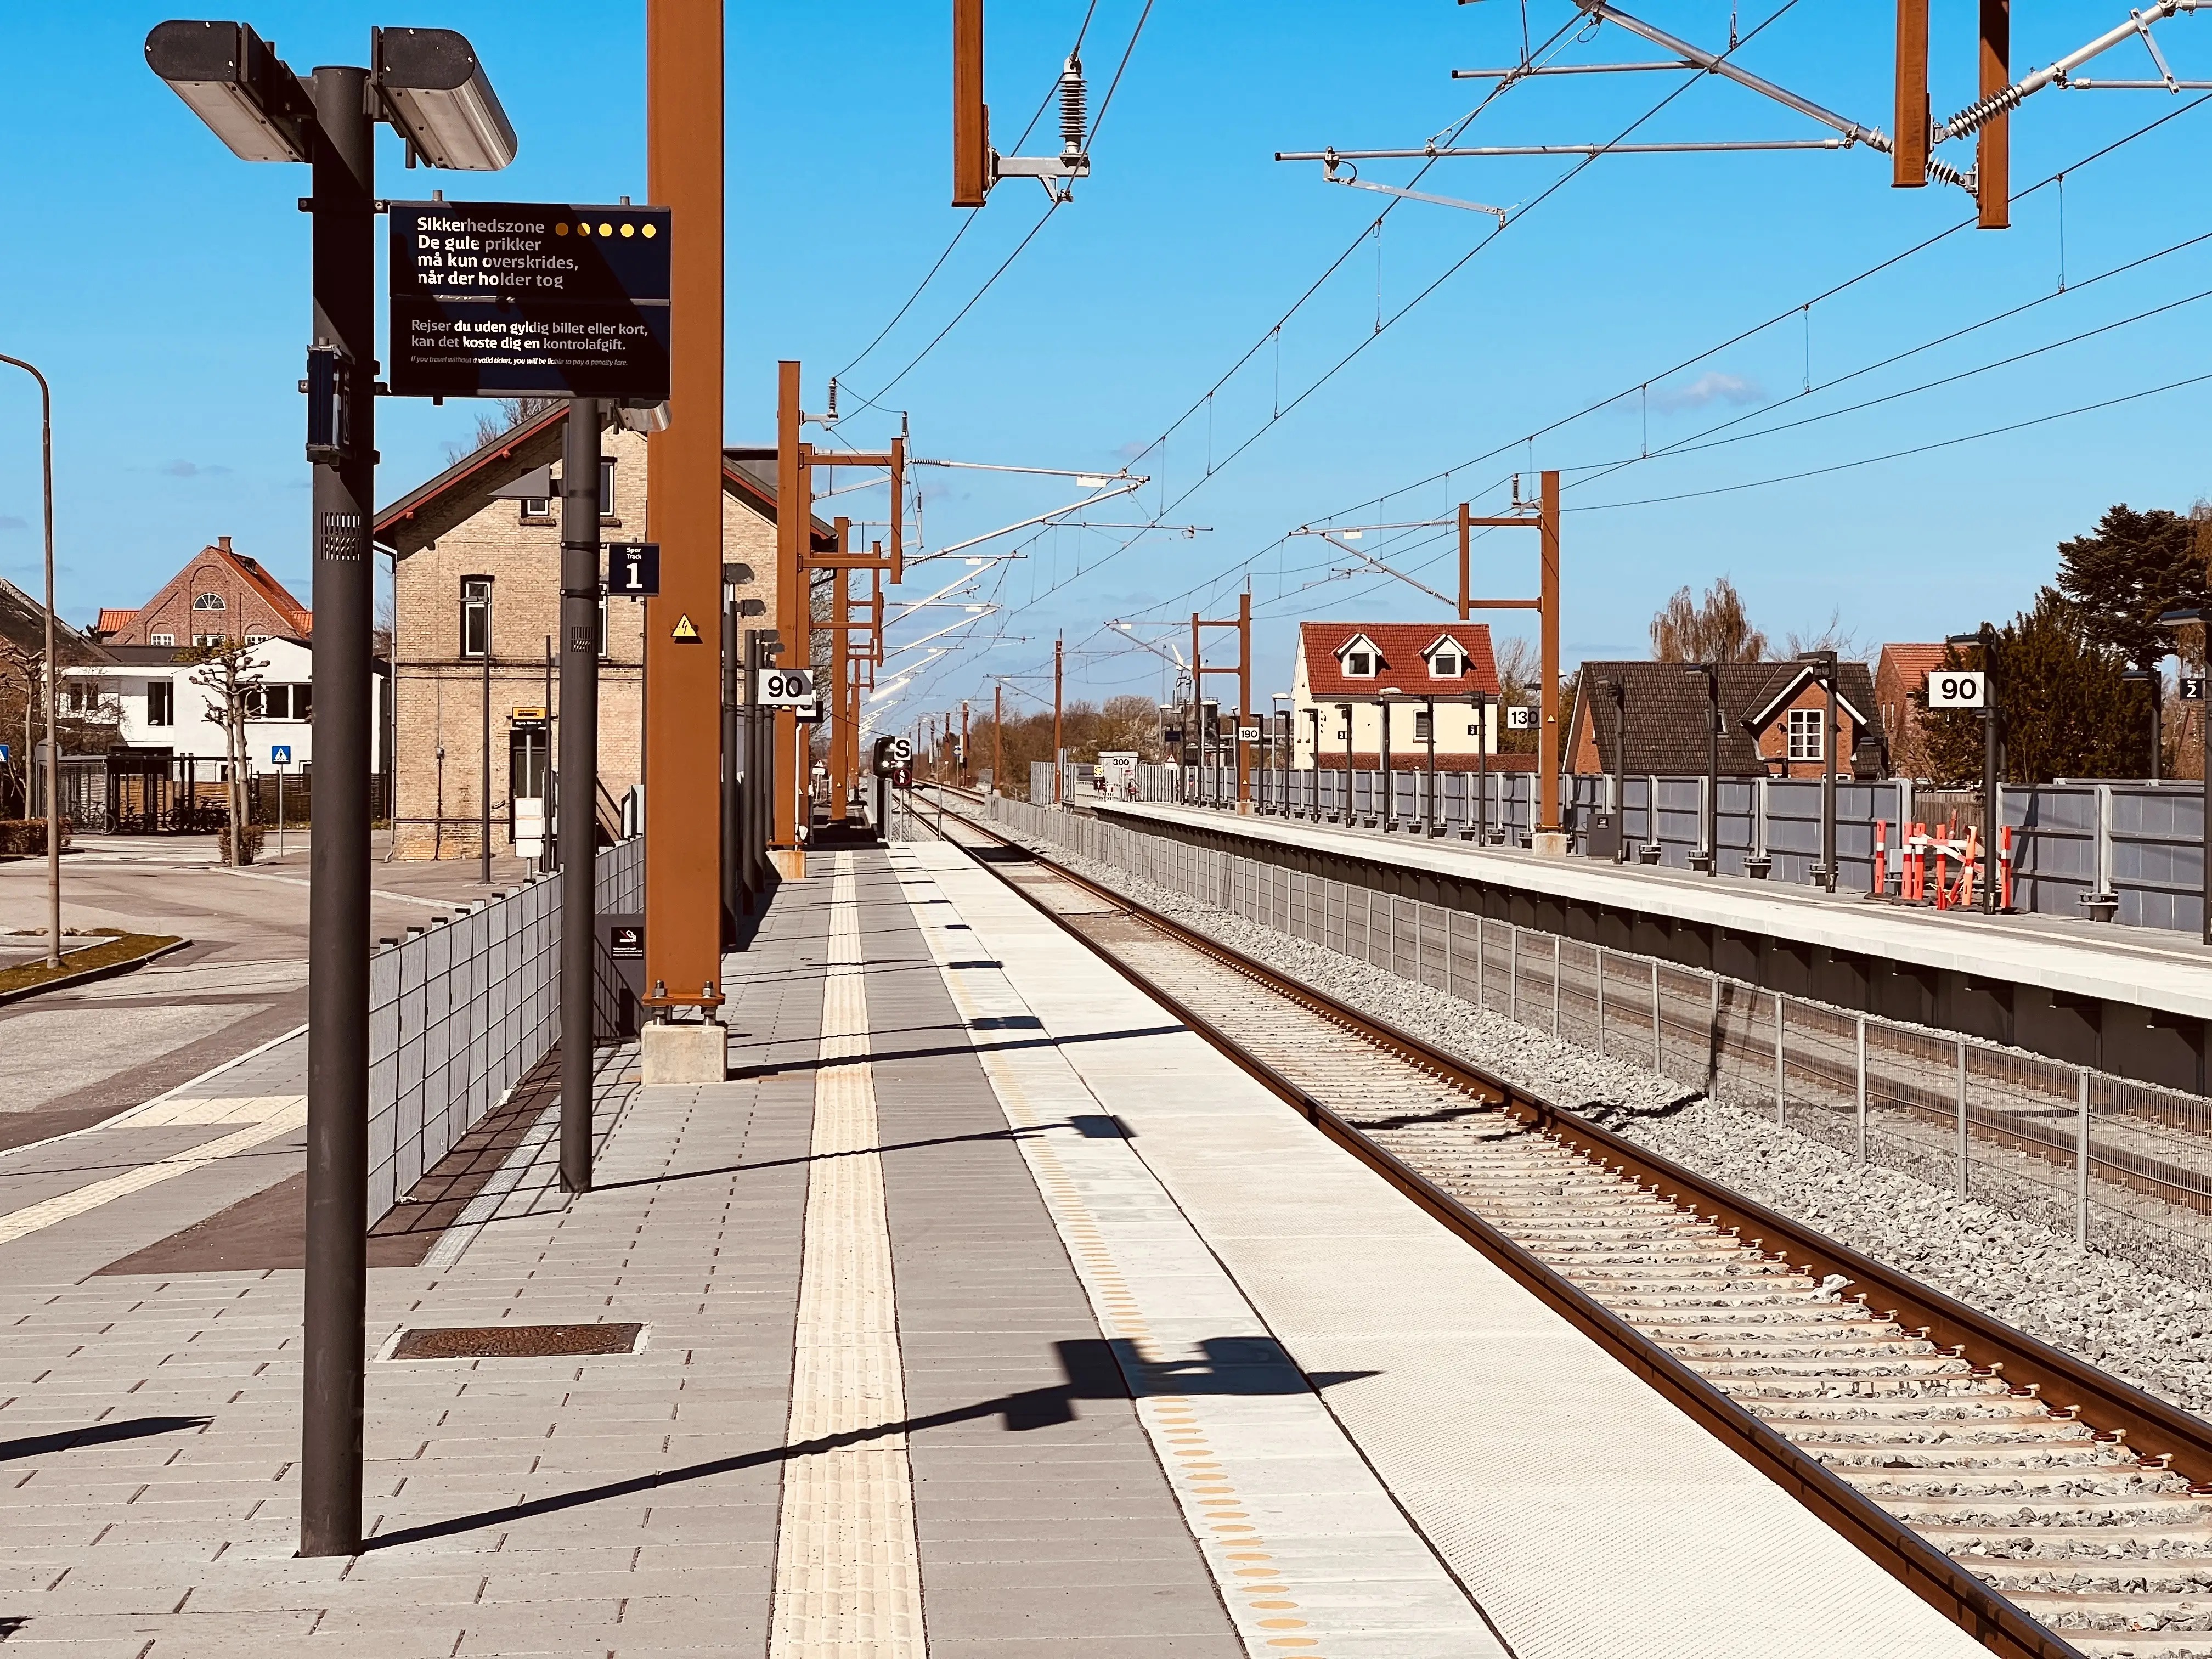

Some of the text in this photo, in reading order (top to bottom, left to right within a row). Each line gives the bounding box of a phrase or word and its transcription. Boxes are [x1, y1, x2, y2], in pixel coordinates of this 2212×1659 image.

[417, 217, 545, 233] Sikkerhedszone
[418, 235, 541, 253] De gule prikker
[417, 251, 578, 271] må kun overskrides,
[418, 269, 563, 289] når der holder tog
[411, 319, 648, 336] Rejser du uden gyldig billet eller kort,
[411, 335, 625, 352] kan det koste dig en kontrolafgift.
[626, 563, 642, 588] 1
[768, 676, 803, 698] 90
[1942, 678, 1977, 700] 90
[2187, 685, 2197, 698] 2
[1511, 710, 1539, 725] 130
[1241, 730, 1257, 738] 190
[895, 740, 910, 758] S
[1094, 766, 1102, 776] S
